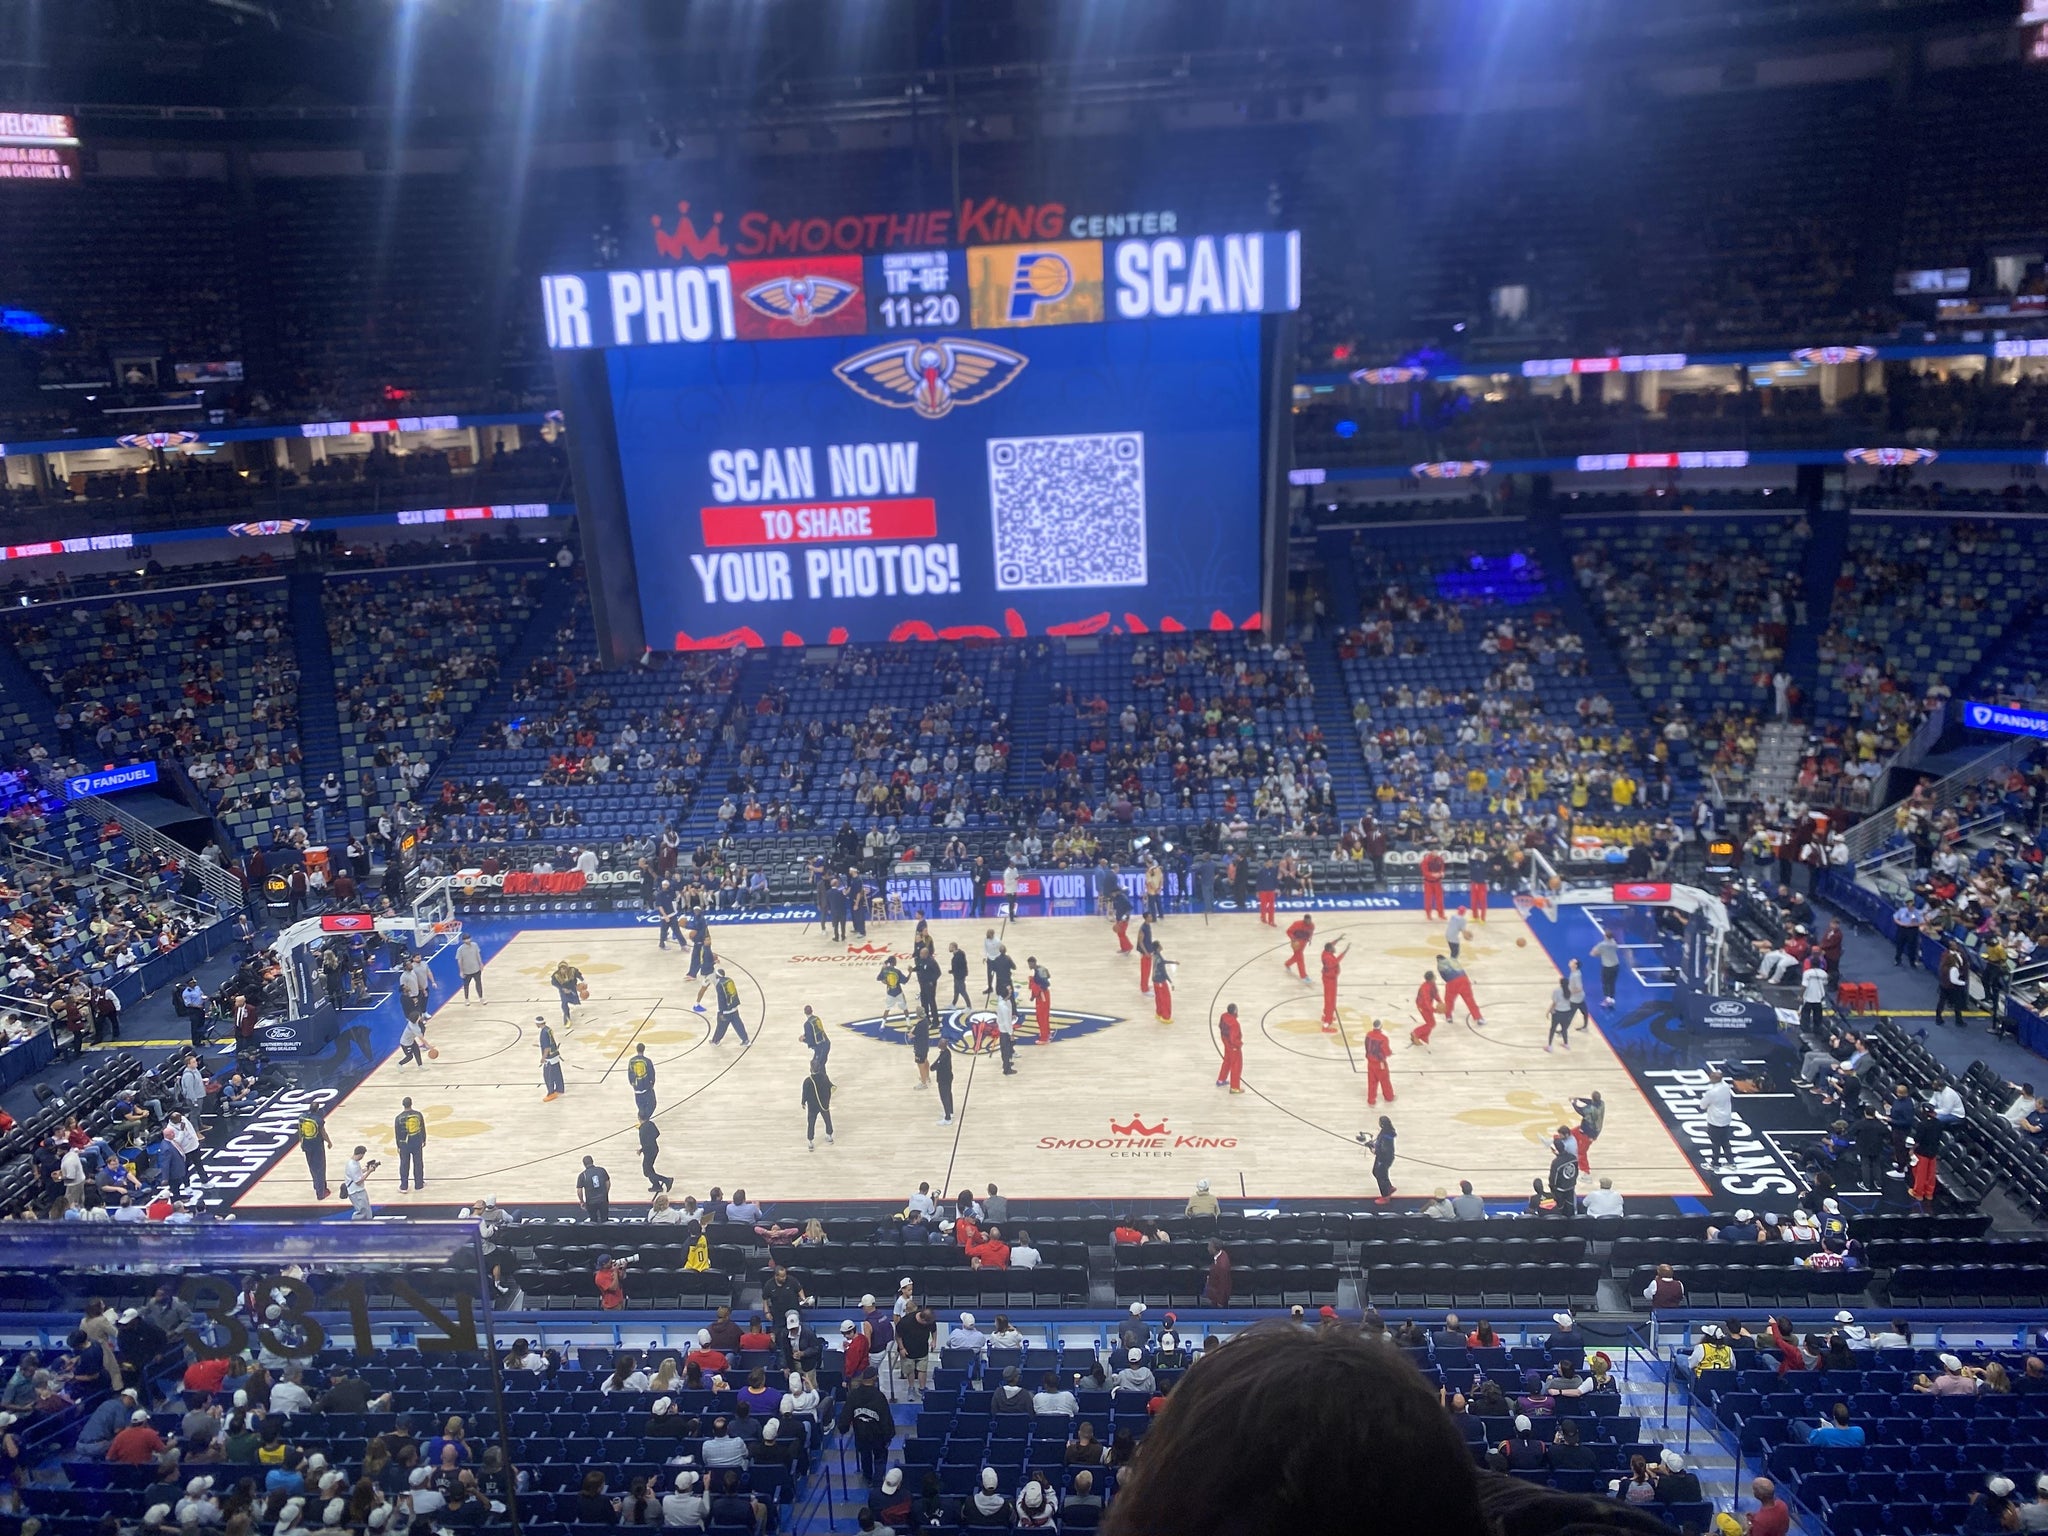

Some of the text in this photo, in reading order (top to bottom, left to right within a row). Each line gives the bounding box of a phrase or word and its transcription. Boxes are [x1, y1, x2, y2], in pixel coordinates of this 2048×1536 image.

[736, 211, 952, 255] SMOOTHIE
[1070, 211, 1177, 238] CENTER
[883, 266, 949, 295] TIP-OFF
[1115, 233, 1262, 319] SCAN
[879, 294, 960, 328] 11:20
[708, 441, 919, 503] SCAN NOW
[761, 507, 873, 540] TO SHARE
[690, 543, 961, 603] YOUR PHOTOS!
[93, 769, 150, 789] FANDUEL
[886, 878, 933, 902] SCAN
[1040, 875, 1085, 898] YOUR
[1036, 1137, 1166, 1149] SMOOTHIE
